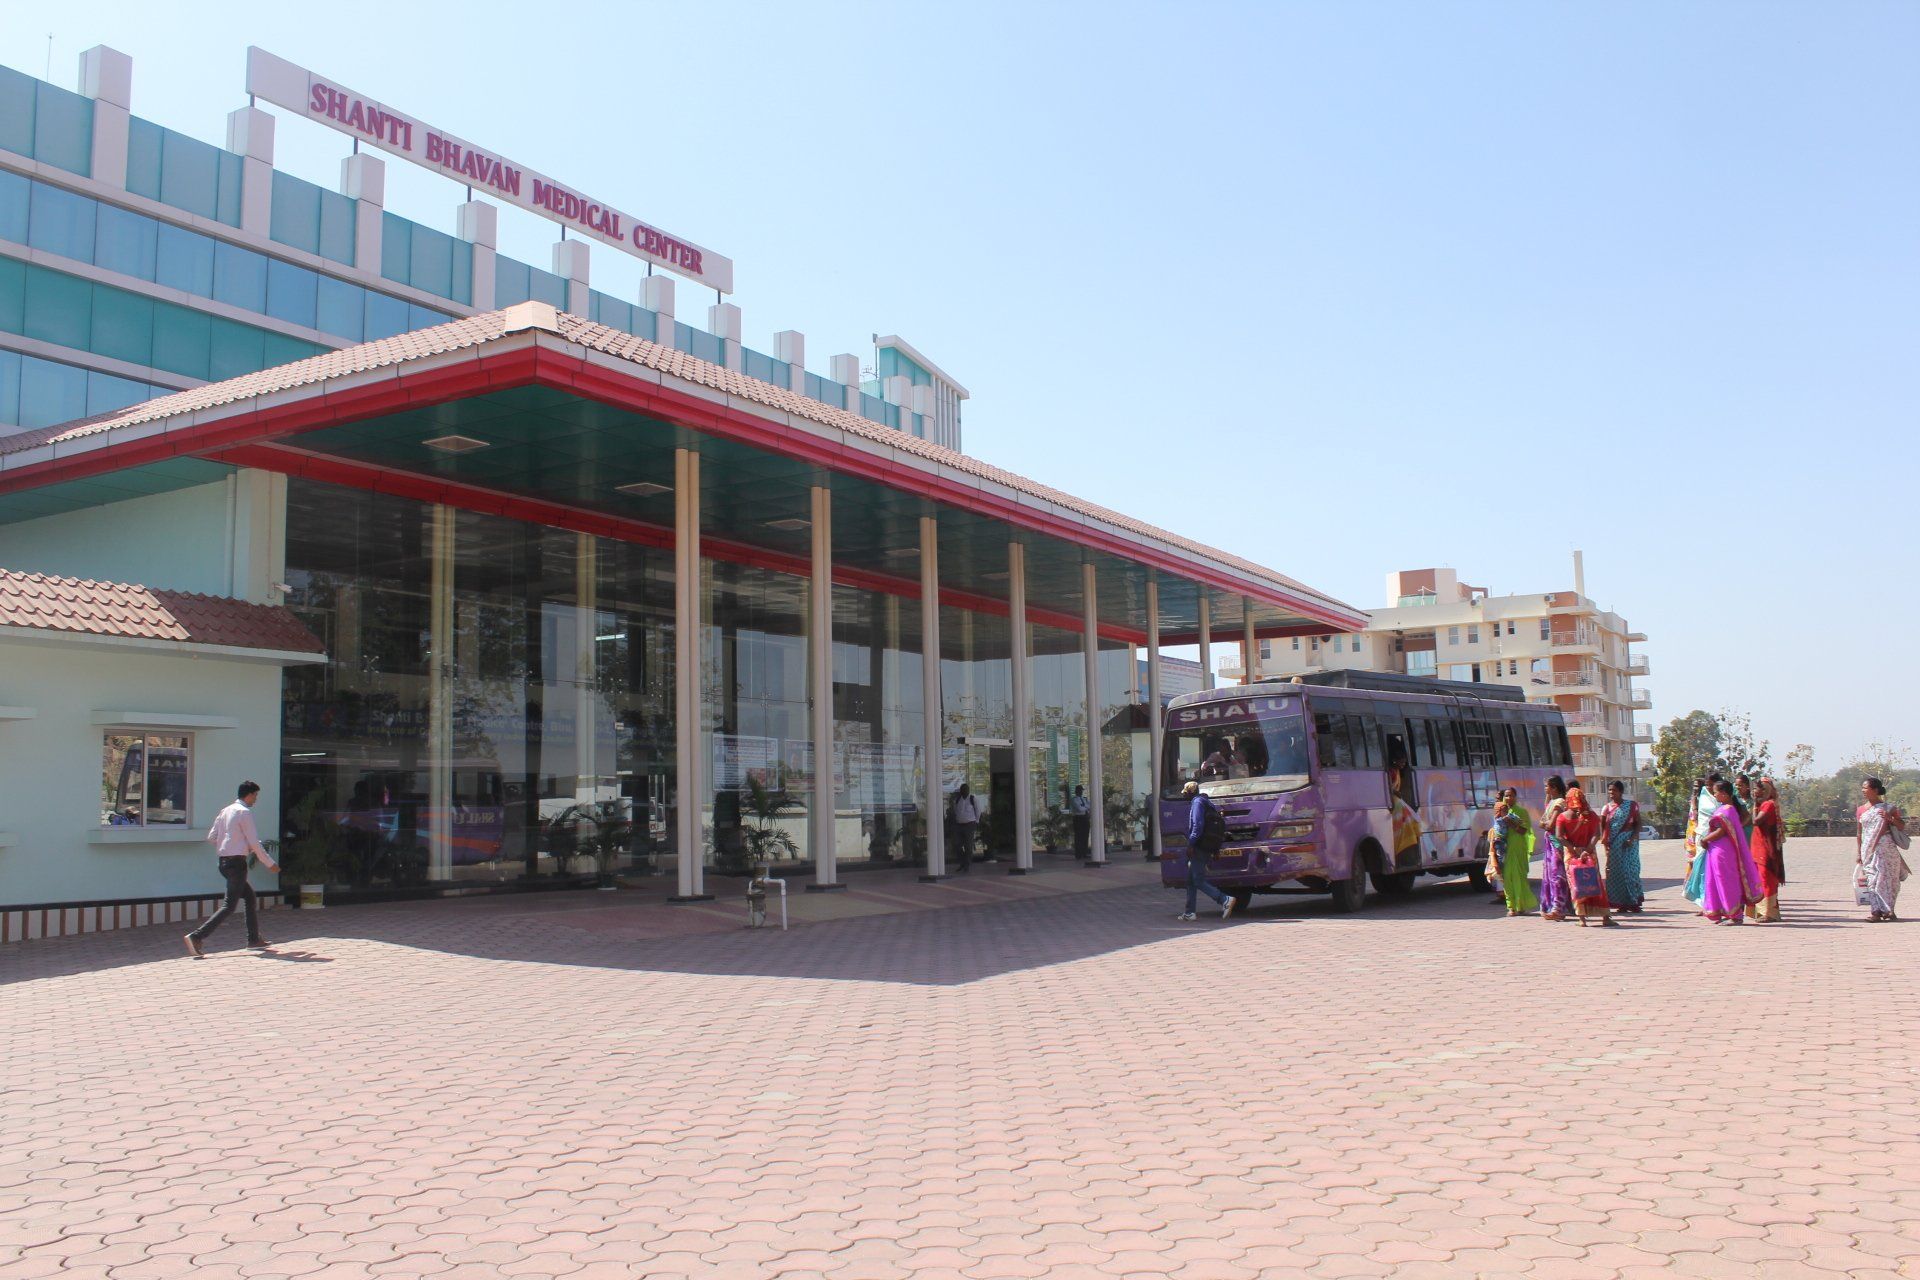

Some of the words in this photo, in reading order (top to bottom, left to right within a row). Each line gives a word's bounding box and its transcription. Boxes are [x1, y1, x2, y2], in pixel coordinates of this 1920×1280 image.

[310, 83, 413, 151] SHANTI
[426, 131, 521, 197] BHAVAN
[532, 178, 624, 241] MEDICAL
[633, 224, 703, 275] CENTER
[1179, 698, 1289, 722] SHALU
